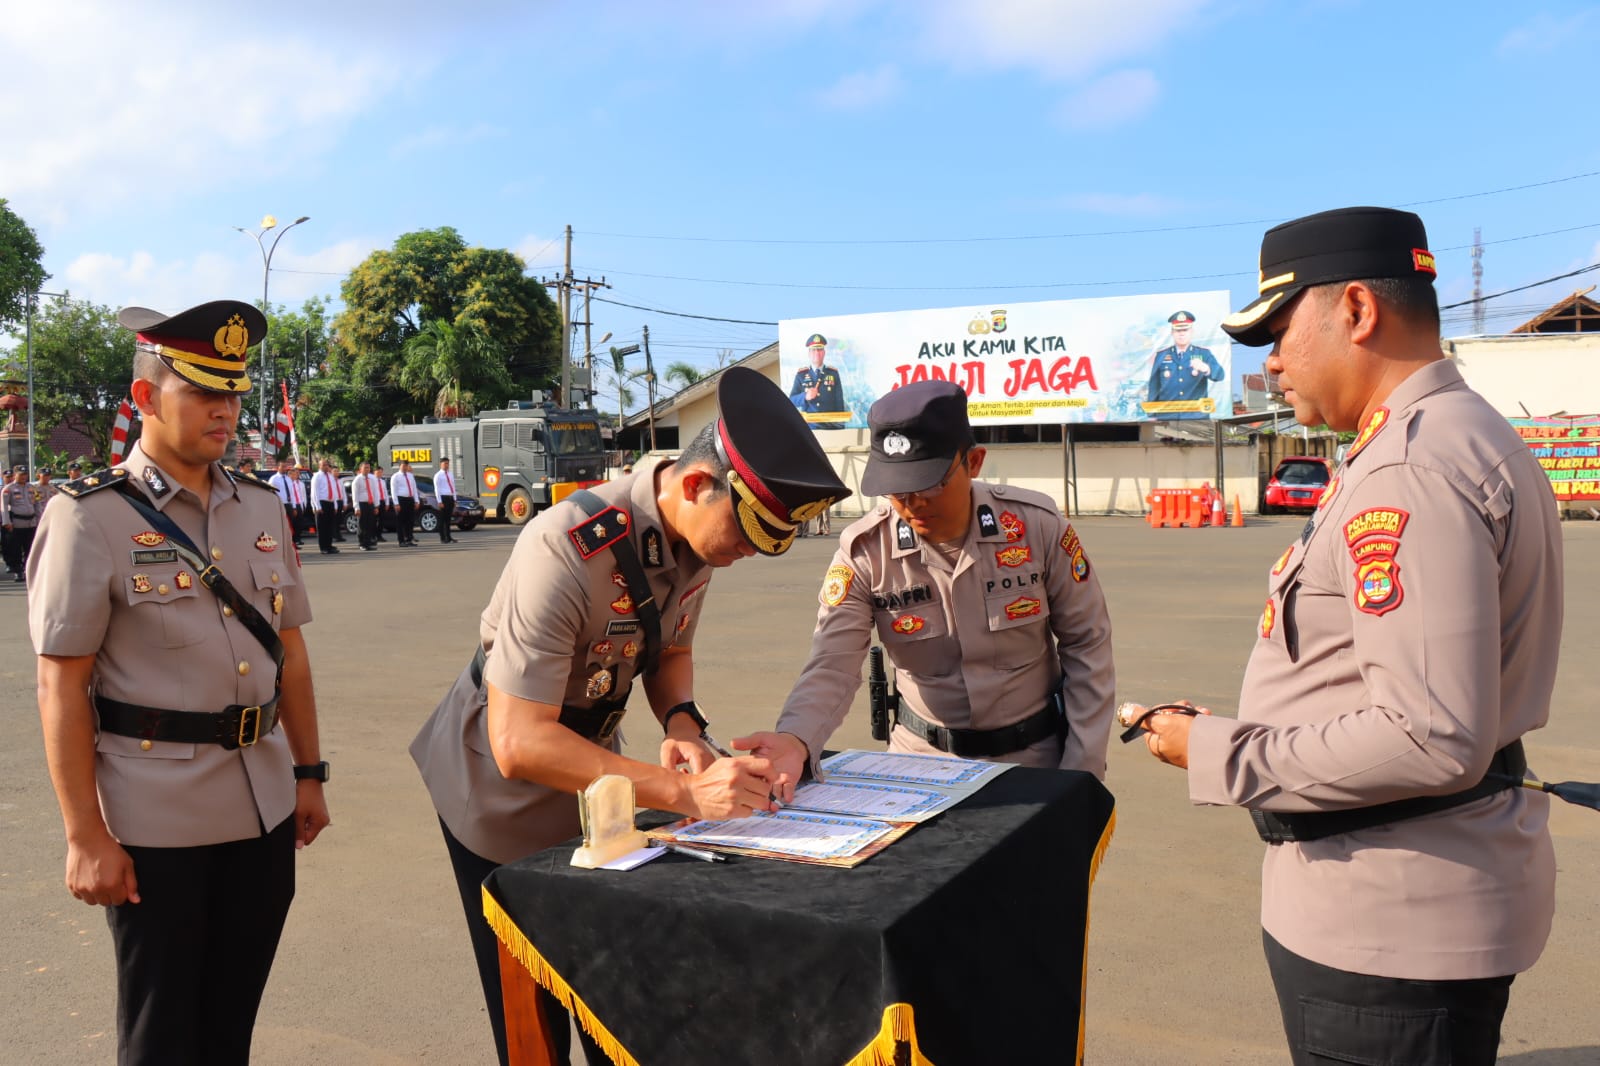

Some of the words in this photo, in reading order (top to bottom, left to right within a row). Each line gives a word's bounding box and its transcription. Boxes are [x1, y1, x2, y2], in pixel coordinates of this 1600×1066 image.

[918, 342, 955, 359] AKU
[963, 339, 1016, 357] KAMU
[1024, 336, 1066, 354] KITA
[1003, 356, 1098, 397] JAGA
[1067, 400, 1085, 408] Maju
[990, 408, 1032, 417] Masyarakat
[392, 449, 431, 462] POLISI
[1347, 511, 1400, 534] POLRESTA
[1355, 543, 1393, 556] LAMPUNG
